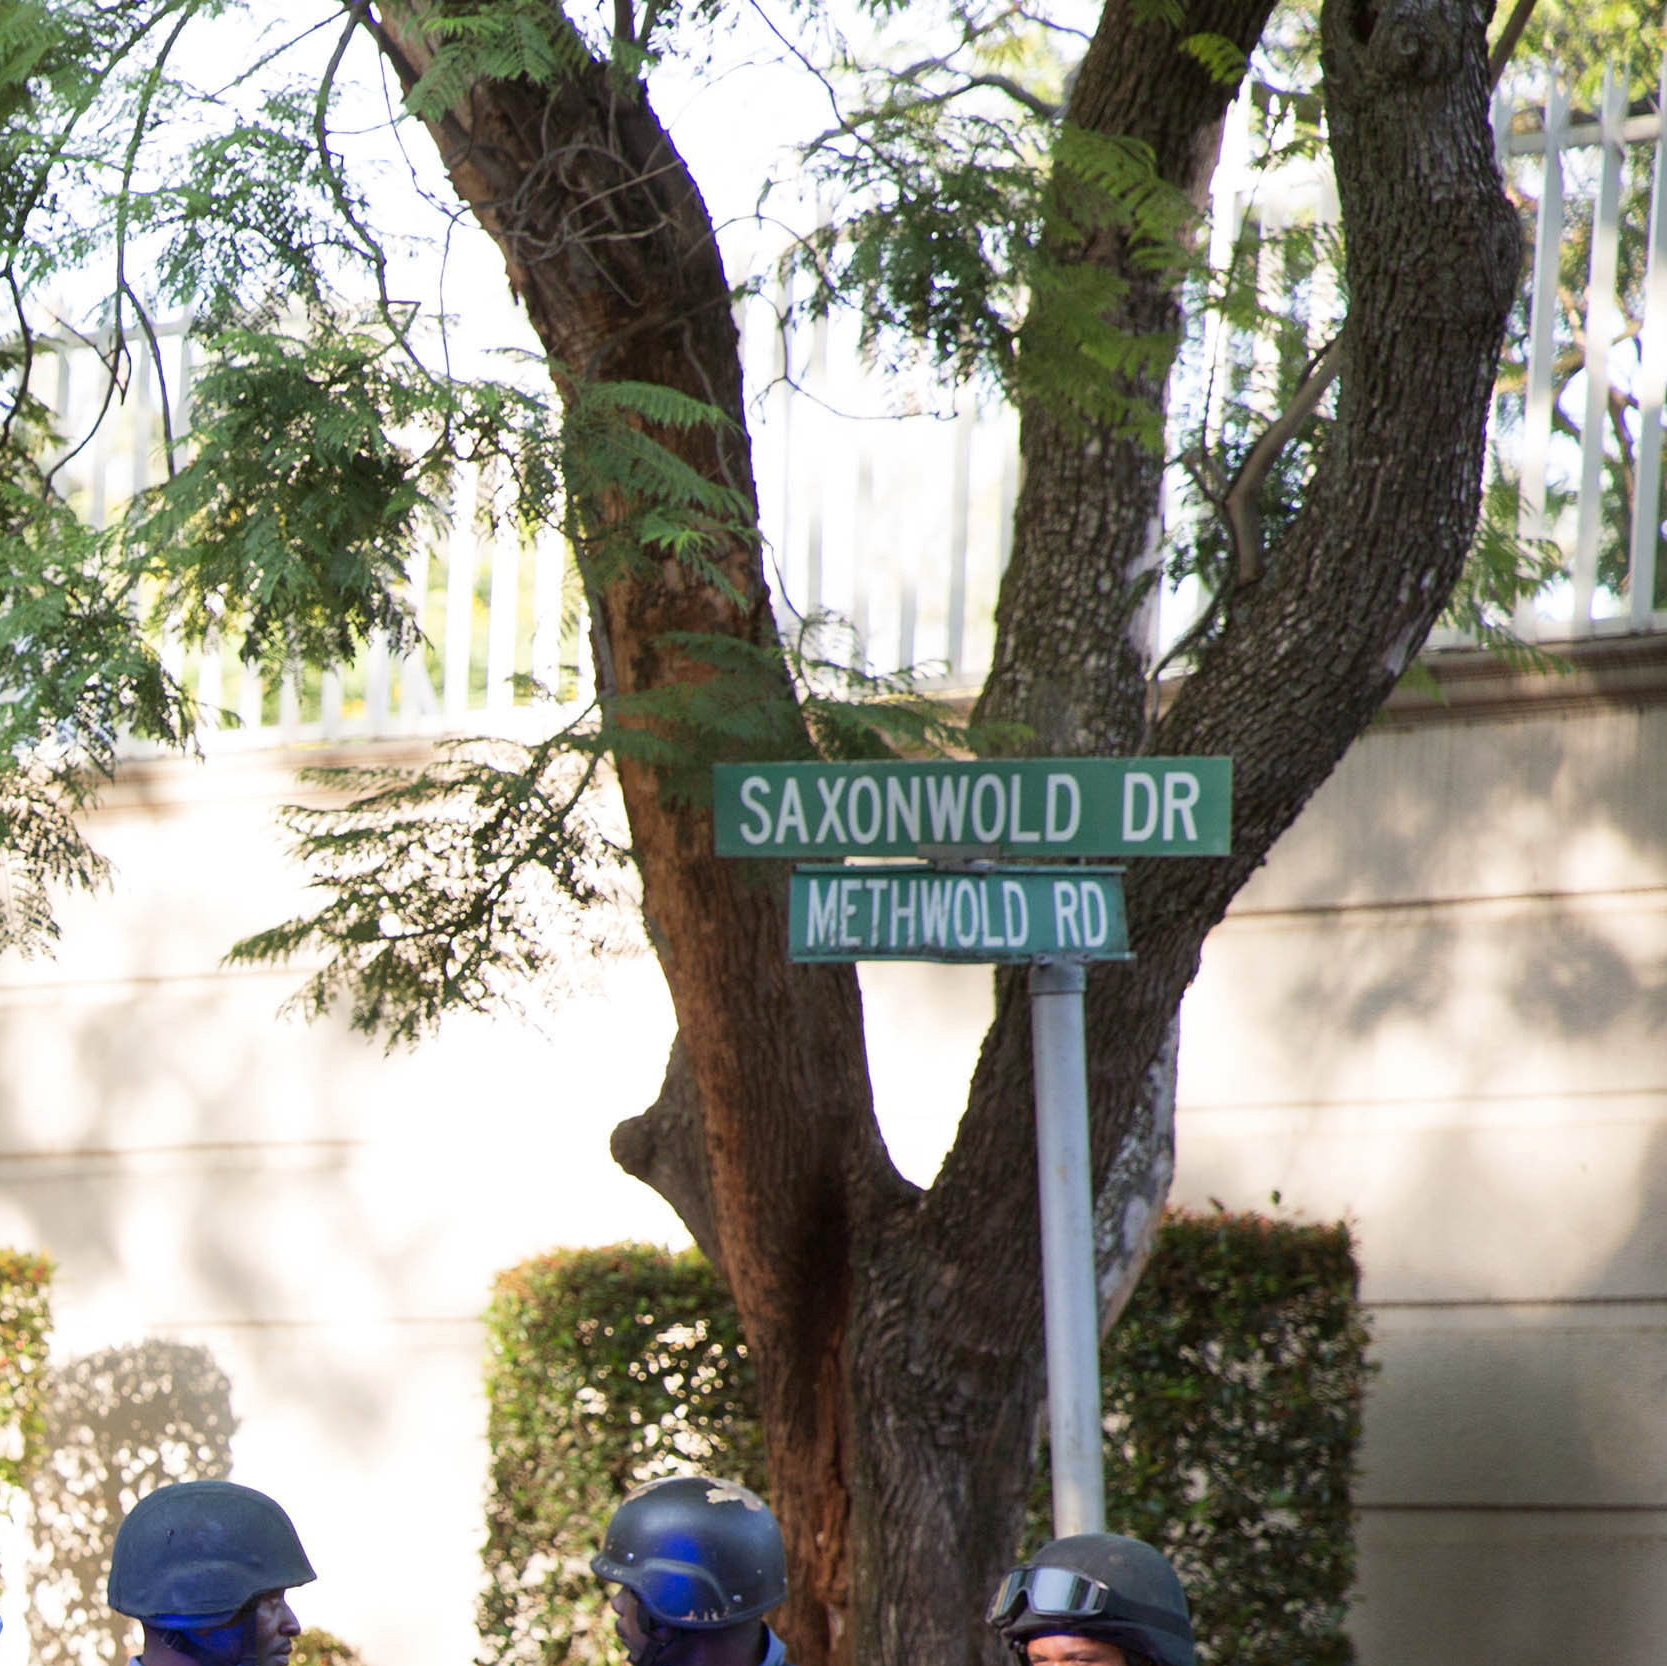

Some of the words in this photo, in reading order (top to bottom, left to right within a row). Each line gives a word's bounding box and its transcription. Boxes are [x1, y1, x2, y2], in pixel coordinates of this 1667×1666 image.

[738, 772, 1083, 847] SAXONWOLD
[1121, 769, 1201, 844] DR
[805, 878, 1030, 949] METHWOLD
[1053, 879, 1110, 949] RD
